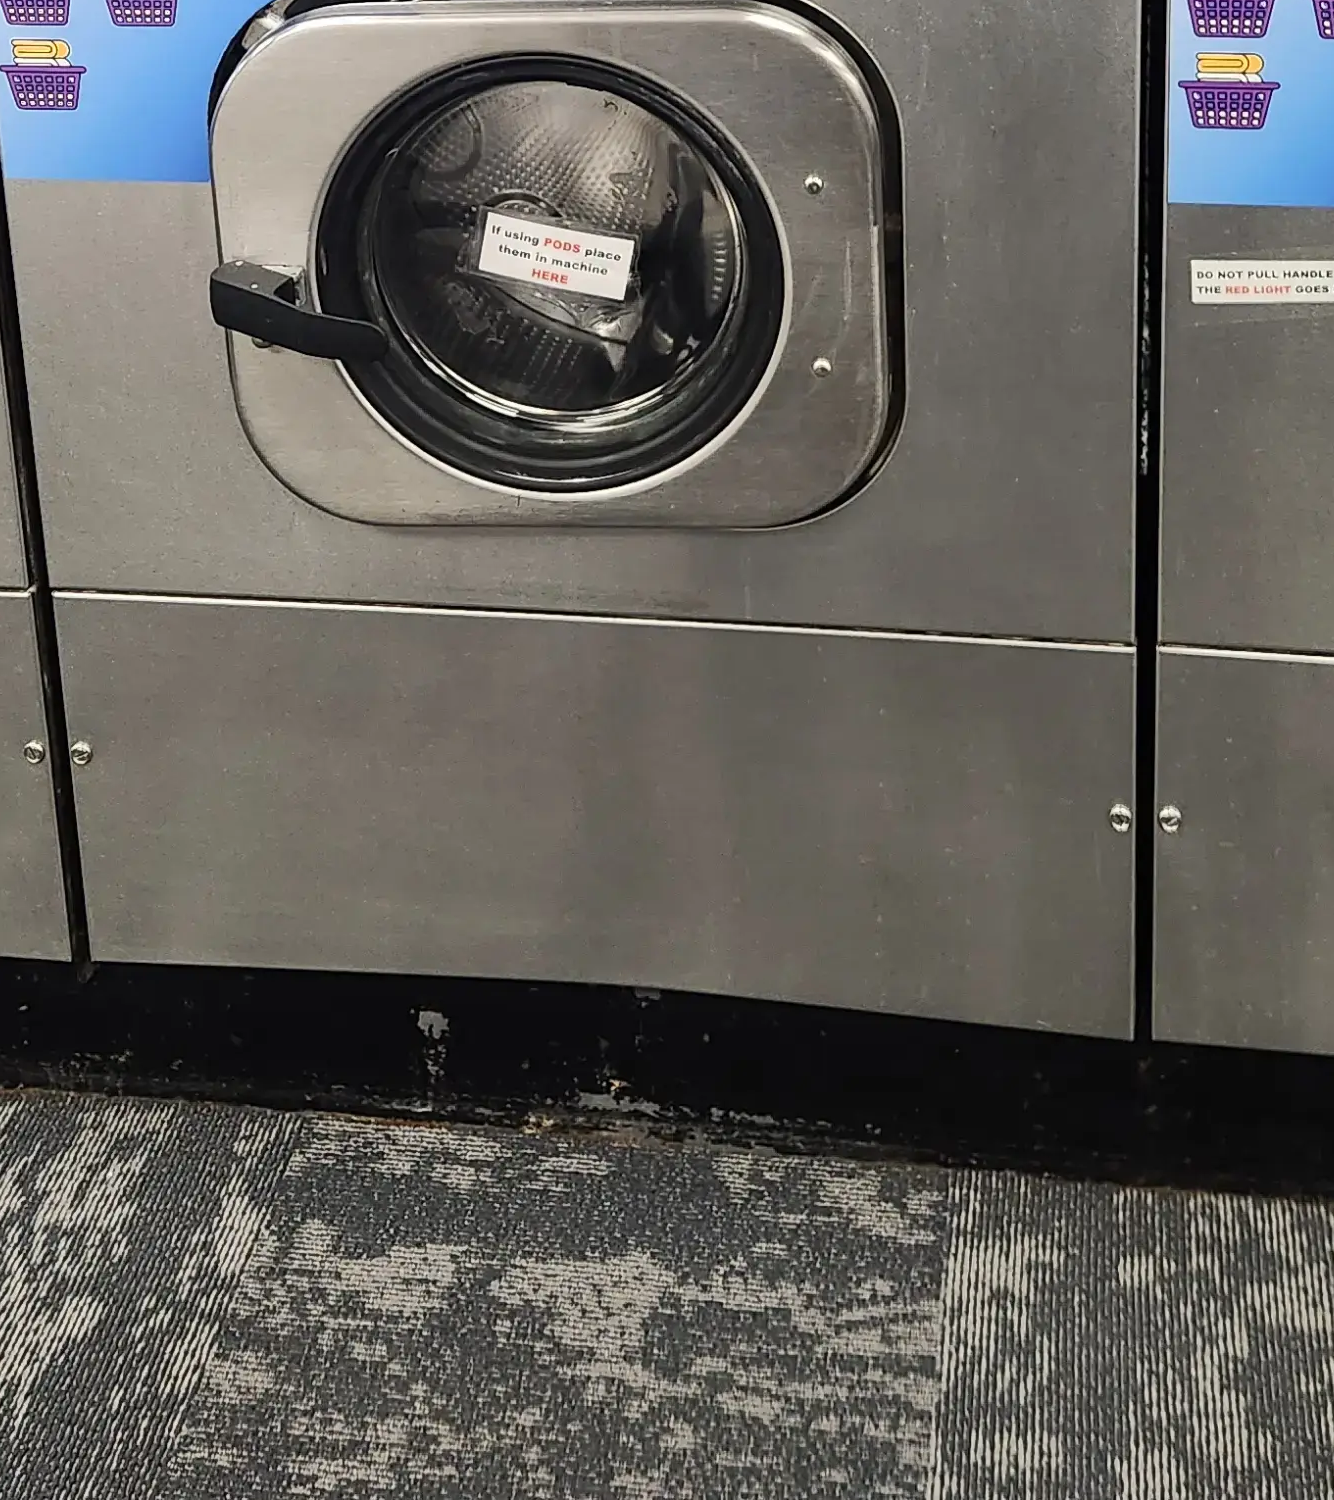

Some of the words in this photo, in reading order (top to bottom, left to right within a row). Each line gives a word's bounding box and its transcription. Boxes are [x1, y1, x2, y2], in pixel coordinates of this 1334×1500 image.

[491, 224, 501, 235] If
[504, 230, 539, 246] using
[543, 237, 581, 253] PODS
[584, 247, 622, 262] place
[499, 244, 531, 259] them
[535, 252, 547, 263] in
[551, 258, 608, 276] machine
[531, 268, 569, 284] HERE
[1197, 270, 1213, 279] DO
[1218, 270, 1243, 279] NOT
[1248, 270, 1279, 279] PULL
[1283, 270, 1333, 279] HANDLE
[1197, 285, 1222, 294] THE
[1225, 285, 1249, 294] RED
[1253, 285, 1291, 294] LIGHT
[1295, 285, 1329, 294] GOES
